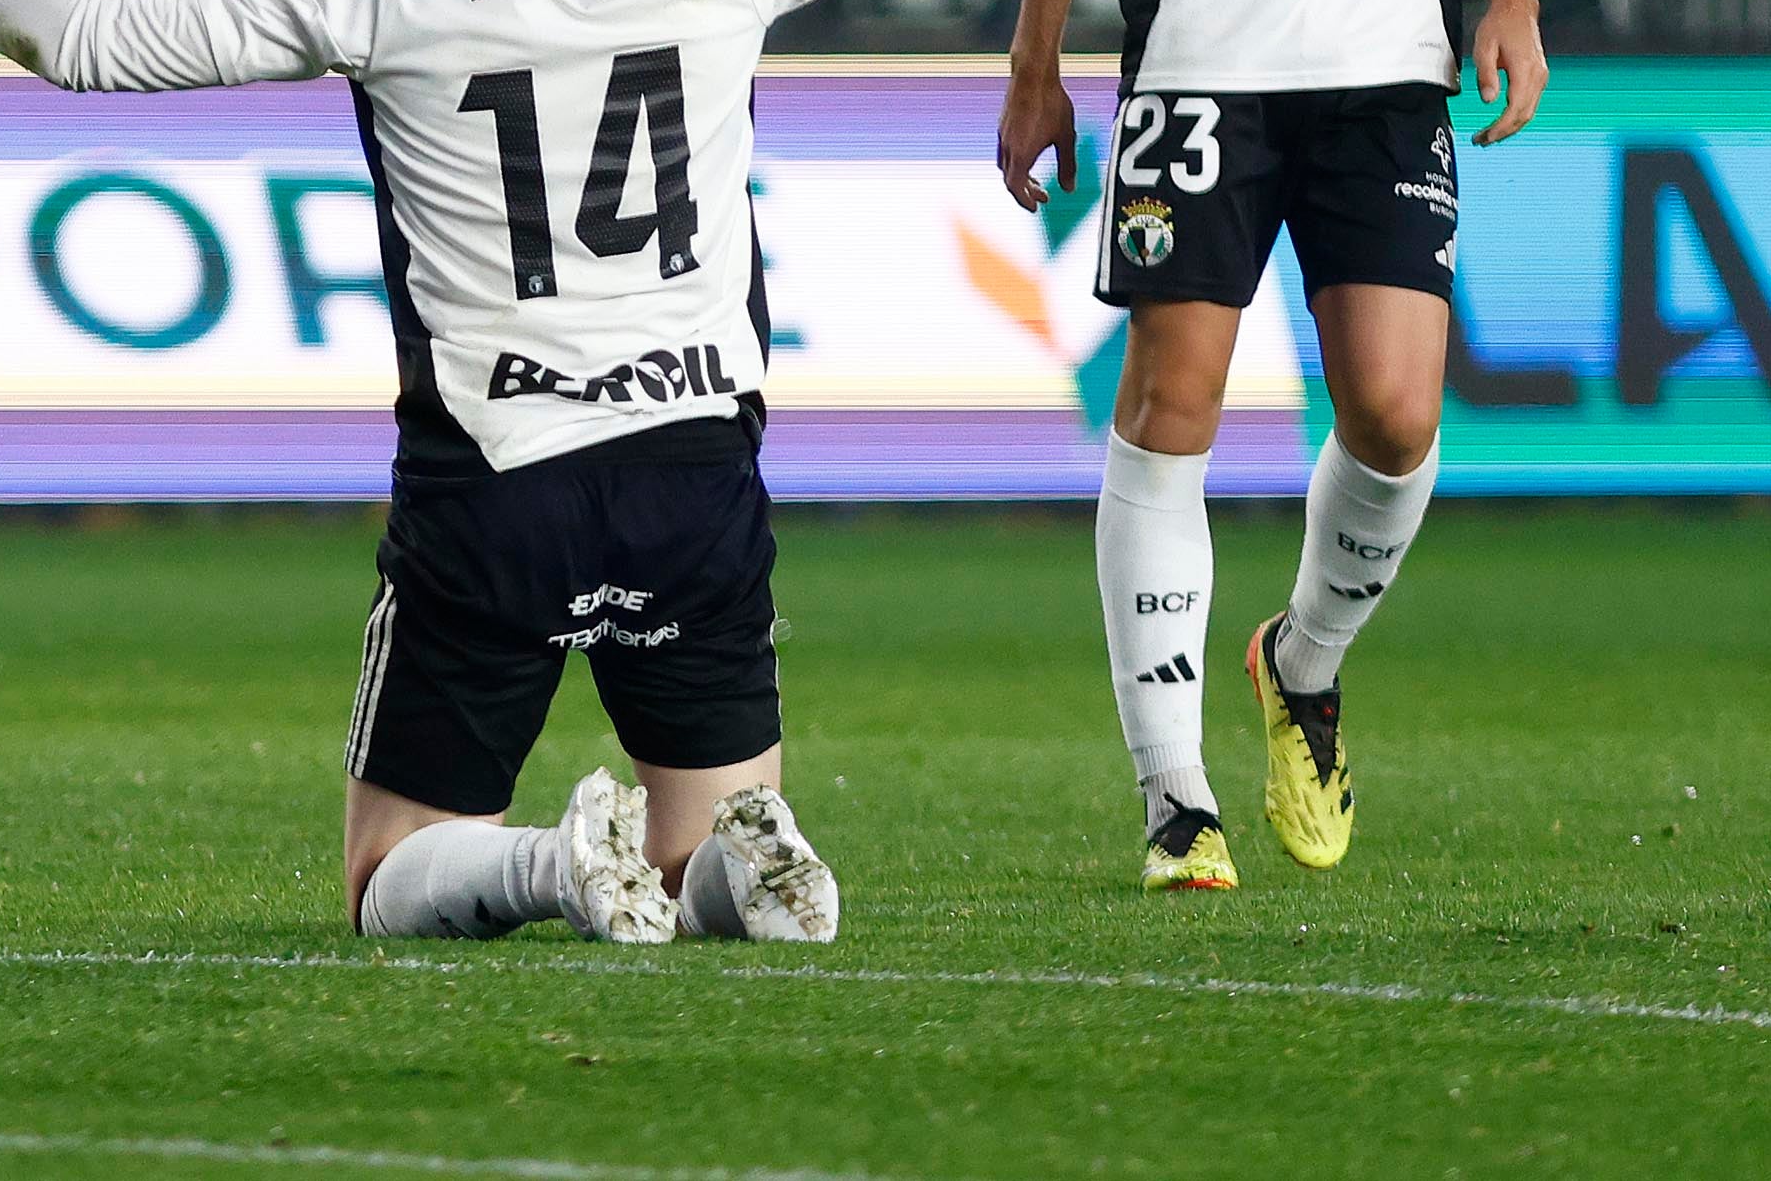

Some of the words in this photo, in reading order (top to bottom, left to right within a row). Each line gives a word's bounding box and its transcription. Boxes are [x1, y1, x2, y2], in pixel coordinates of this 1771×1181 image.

[1119, 93, 1221, 195] 23
[456, 43, 702, 301] 14
[487, 343, 738, 404] BEROIL
[1337, 531, 1406, 560] BCF
[568, 582, 649, 617] EXIDE
[1135, 590, 1200, 614] BCF
